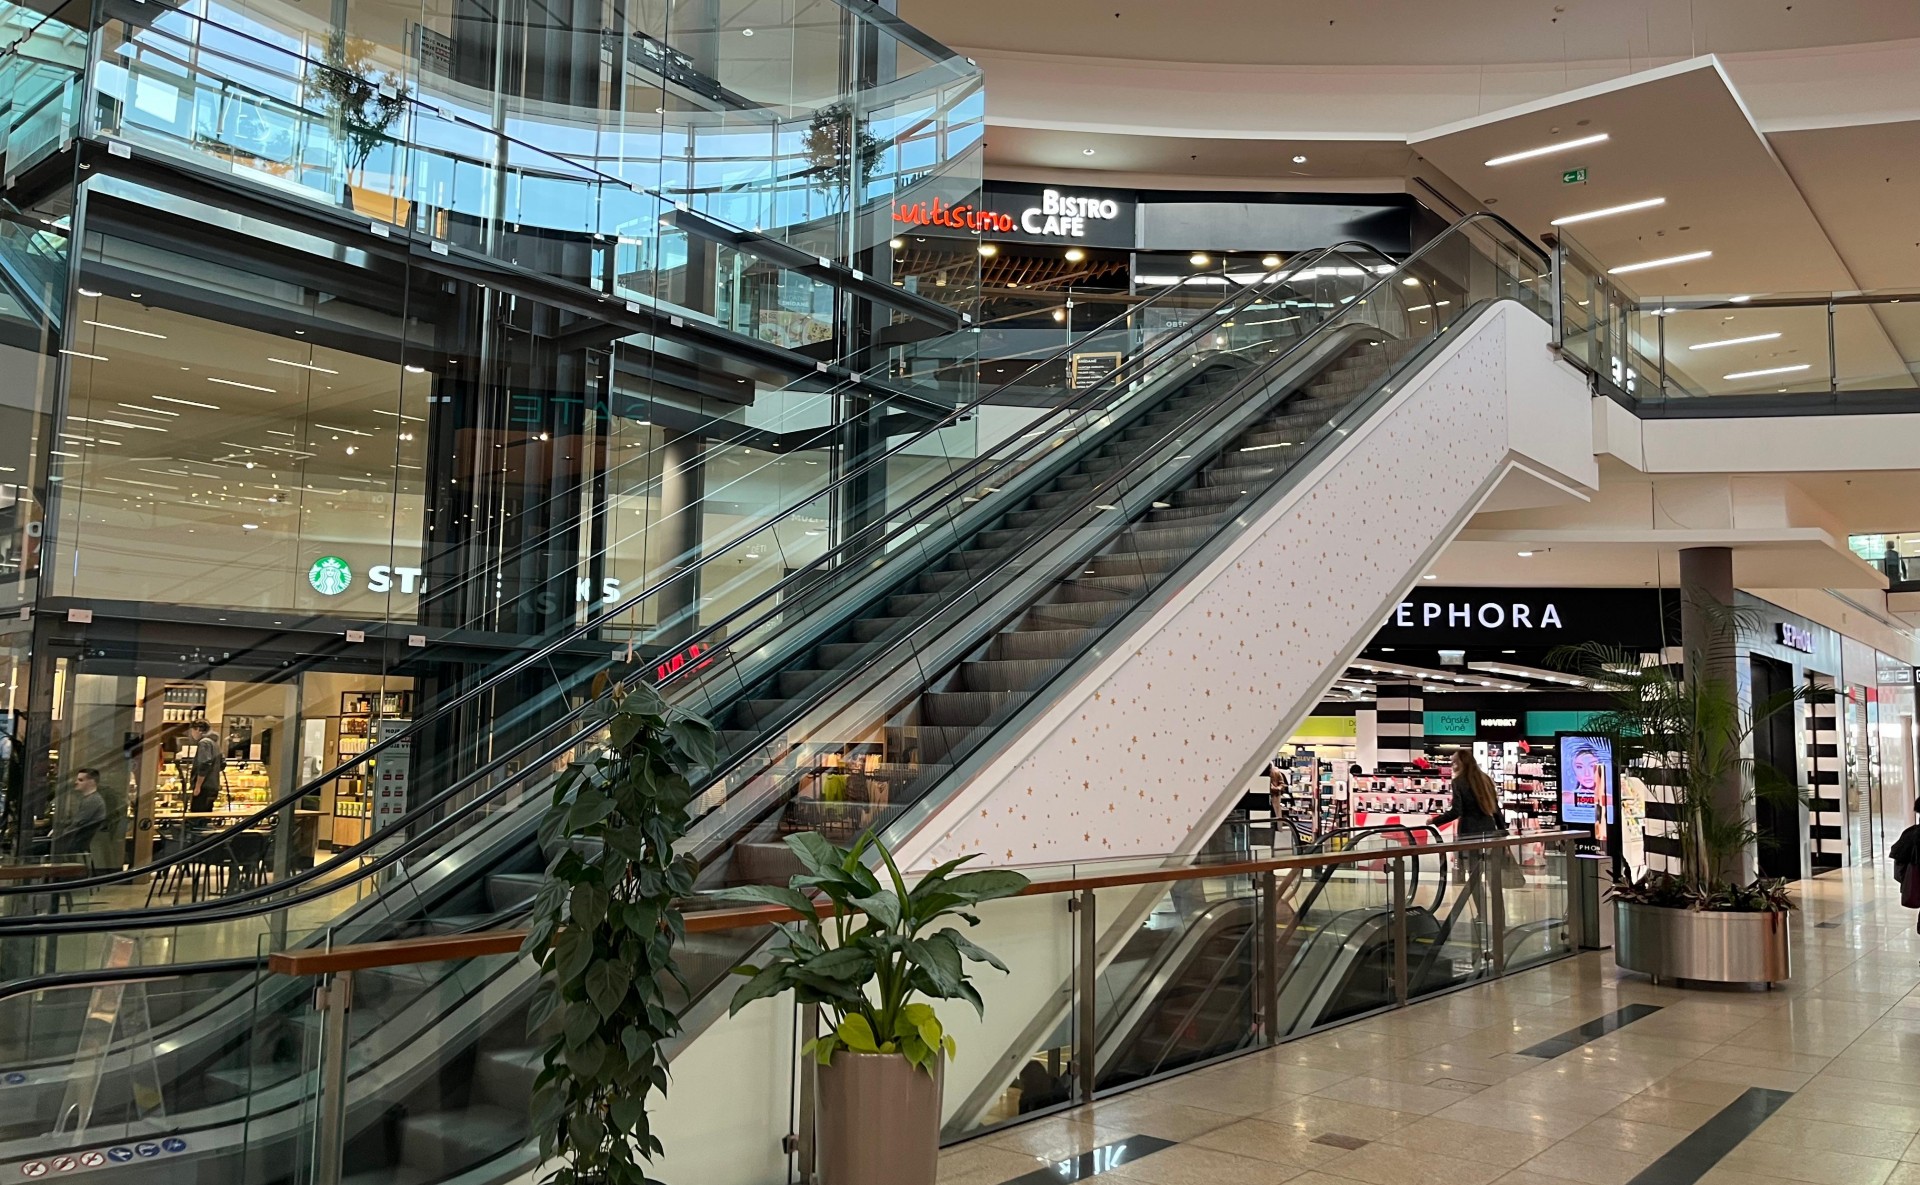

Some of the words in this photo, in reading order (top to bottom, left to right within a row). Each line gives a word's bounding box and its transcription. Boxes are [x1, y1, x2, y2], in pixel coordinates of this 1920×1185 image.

[1042, 189, 1118, 220] BISTRO
[1021, 207, 1084, 237] CAFÉ
[1382, 602, 1562, 629] EPHORA
